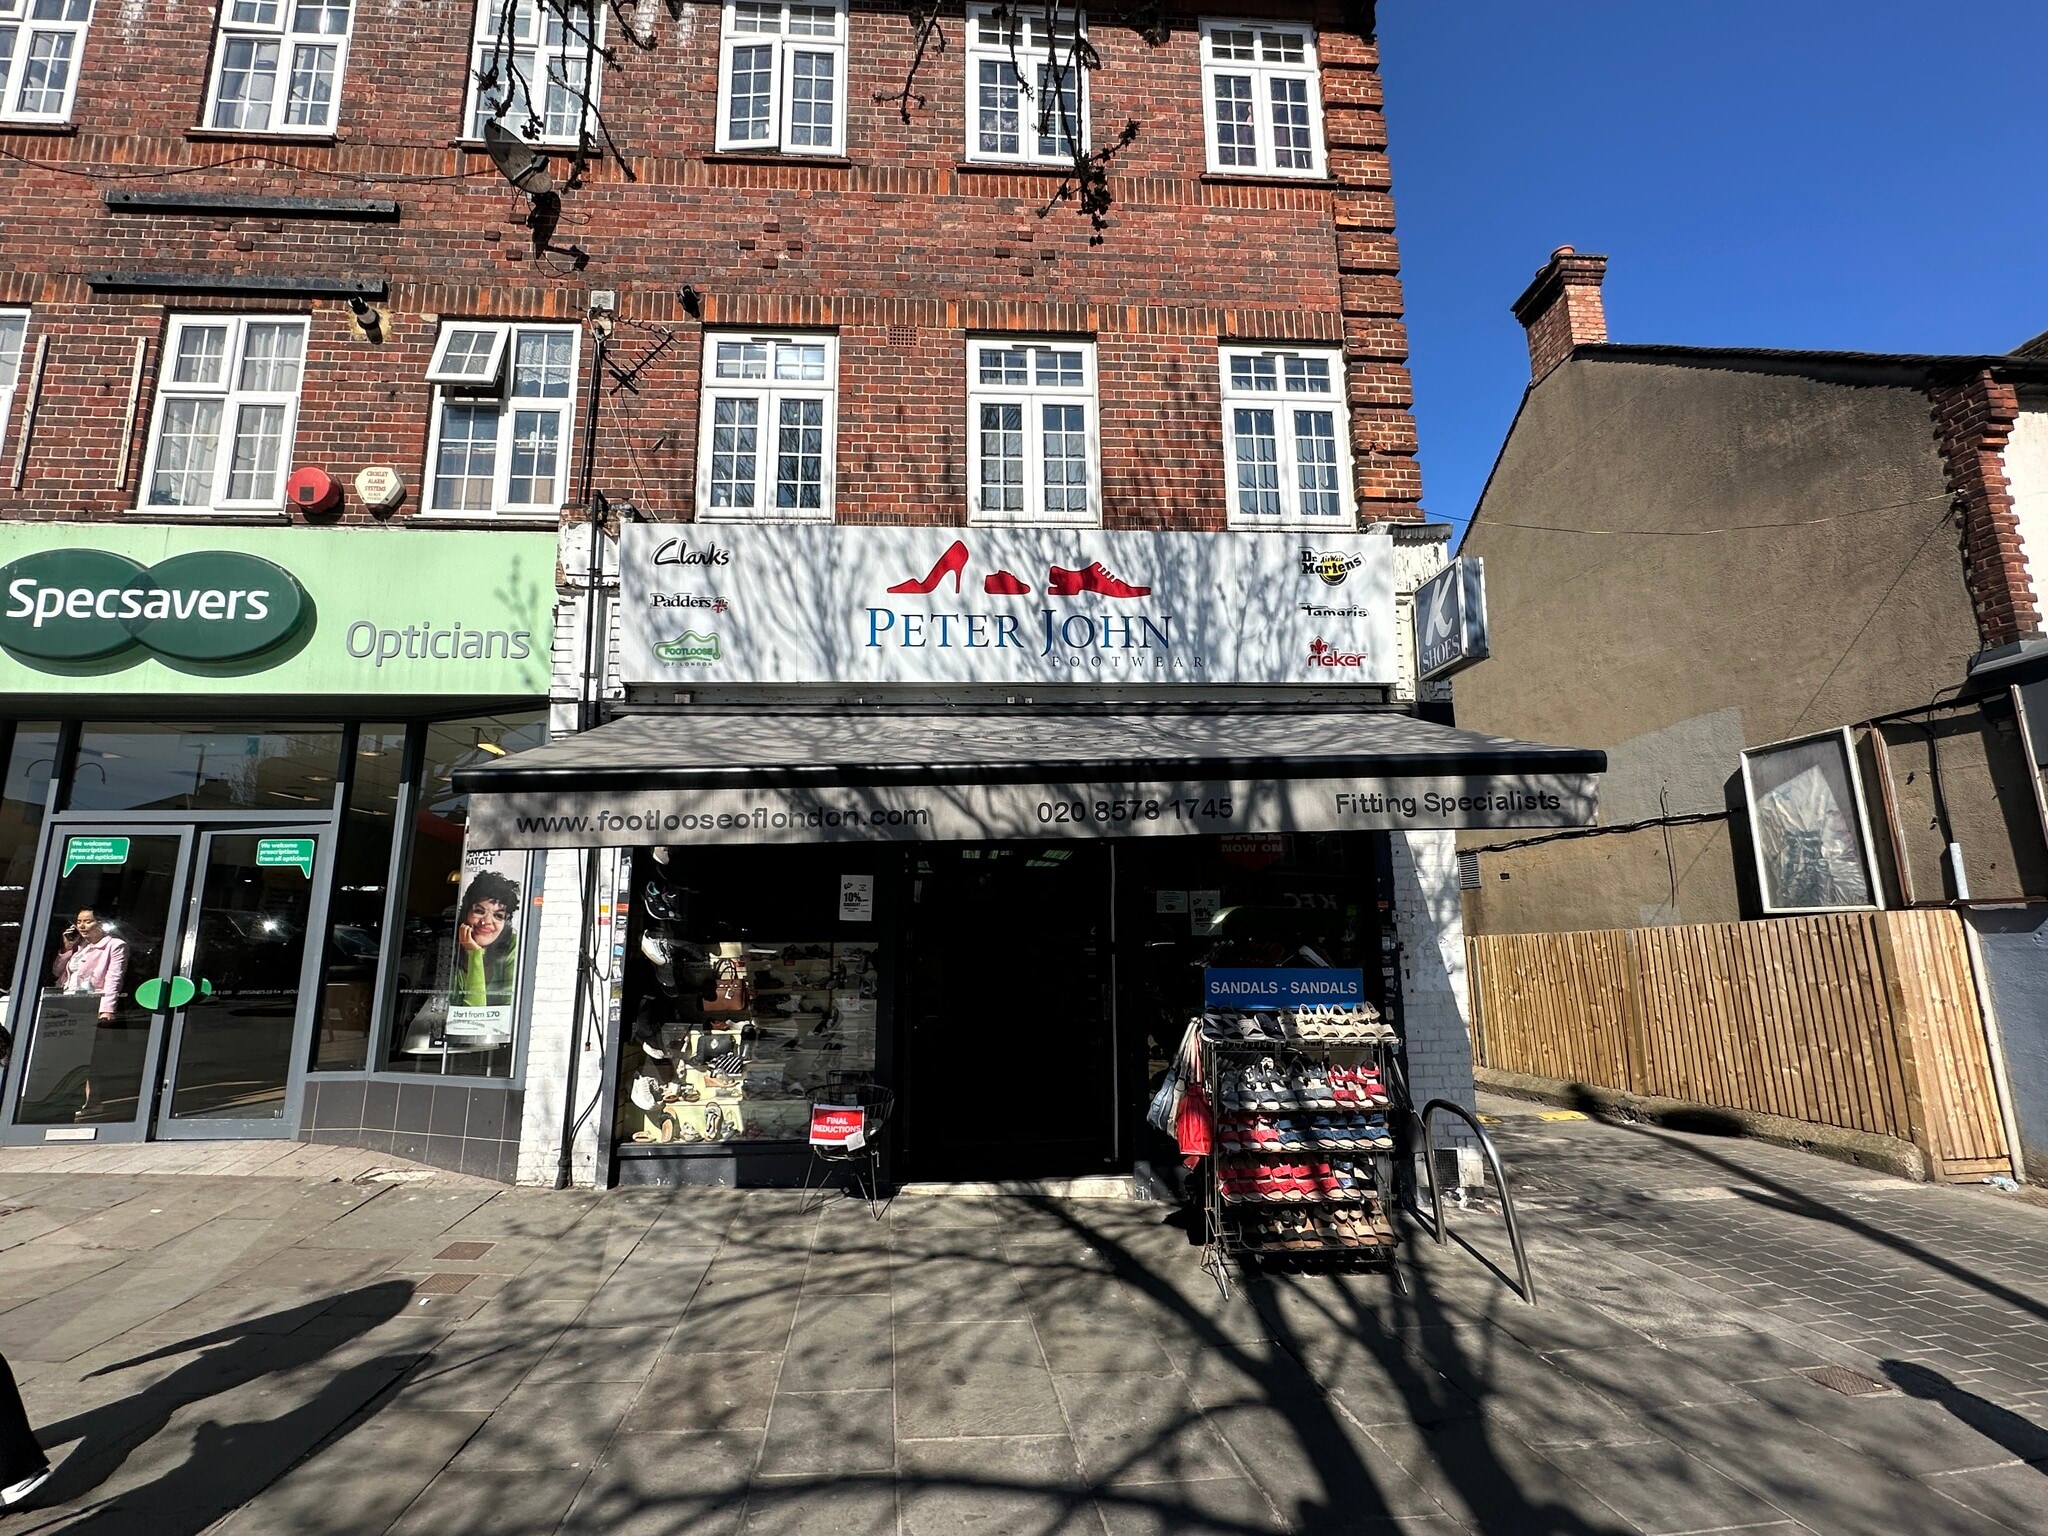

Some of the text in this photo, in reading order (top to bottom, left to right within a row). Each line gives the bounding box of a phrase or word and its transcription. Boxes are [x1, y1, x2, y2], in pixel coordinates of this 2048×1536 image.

[653, 538, 729, 566] Clarks
[1302, 557, 1362, 574] Martens
[6, 578, 270, 628] Specsavers
[652, 594, 711, 608] Padders
[1425, 570, 1454, 647] K
[865, 607, 1172, 657] PETER JOHN
[346, 620, 531, 667] Opticians
[1307, 652, 1366, 667] rieker
[1422, 634, 1460, 672] SHOES
[1051, 656, 1204, 668] FOOTWEAR
[516, 791, 1561, 833] www.footlooseoflondon.com 020 8578 1745 Fitting Specialists
[1221, 843, 1284, 852] NOW ON
[465, 857, 493, 865] MATCH
[844, 892, 861, 902] 10%
[1210, 982, 1279, 994] SANDALS
[1290, 982, 1358, 994] SANDALS
[826, 1116, 848, 1124] FINAL
[813, 1124, 861, 1133] REDUCTIONS
